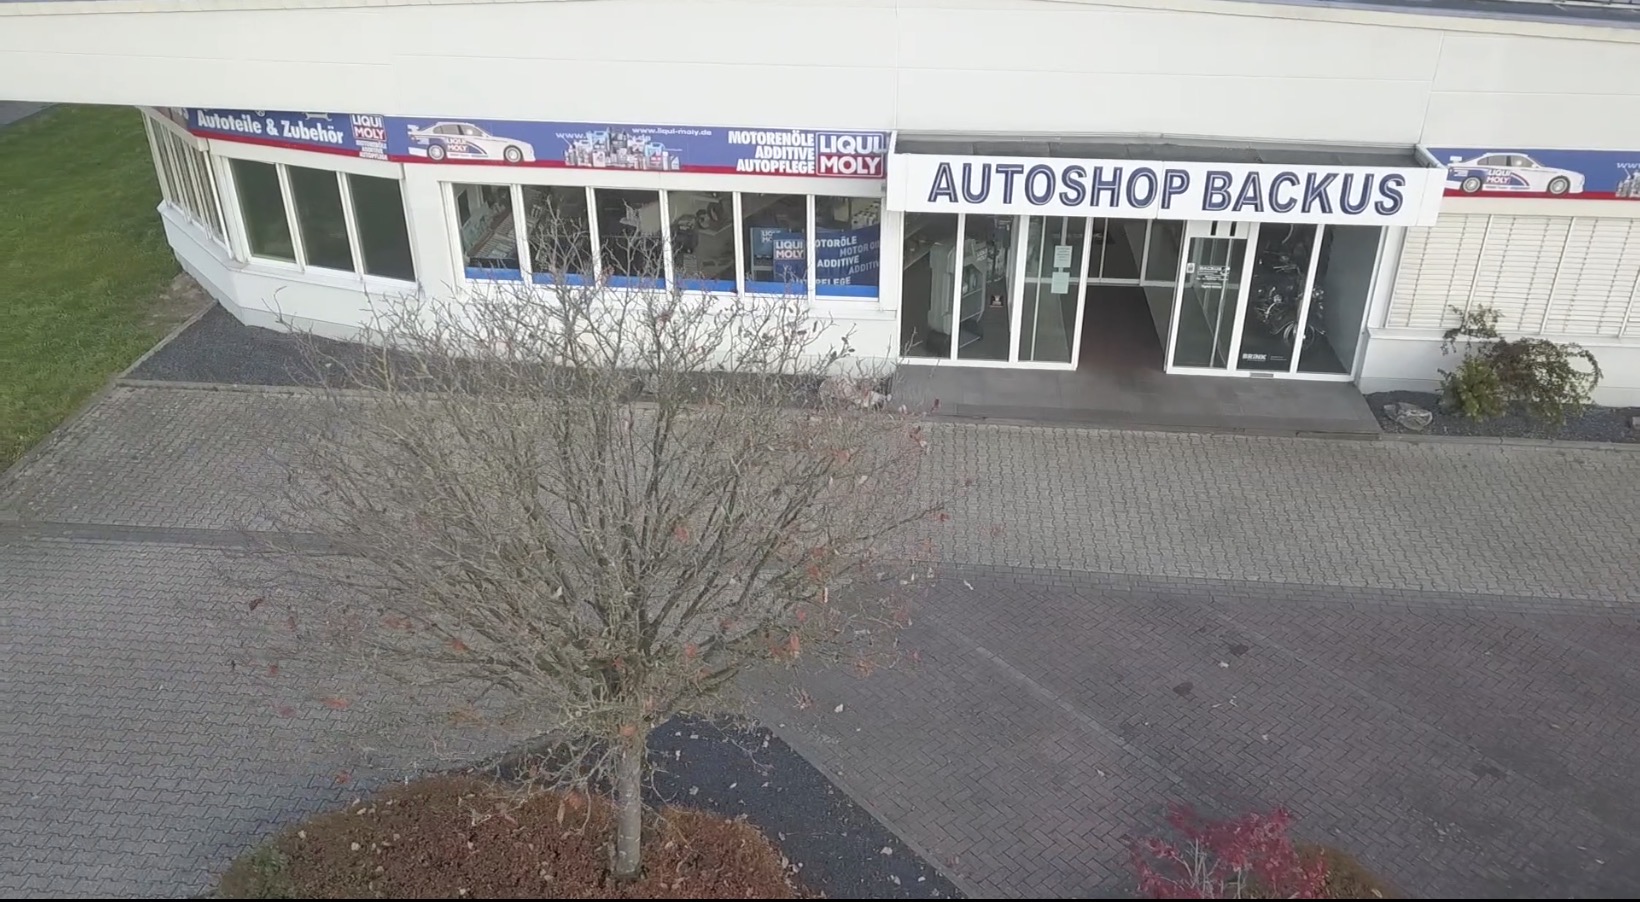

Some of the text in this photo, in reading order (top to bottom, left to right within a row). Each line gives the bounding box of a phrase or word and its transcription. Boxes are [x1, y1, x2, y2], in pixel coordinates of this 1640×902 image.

[198, 109, 262, 134] Autoteile
[266, 117, 279, 136] &
[281, 119, 344, 144] Zubehör
[352, 114, 383, 128] LIQUI
[354, 126, 385, 140] MOLY
[728, 130, 815, 146] MOTORENÖLE
[819, 134, 881, 155] LIQUI
[755, 145, 815, 160] ADDITIVE
[736, 159, 815, 175] AUTOPFLEGE
[820, 156, 881, 175] MOLY
[928, 162, 1406, 216] AUTOSHOP BACKUS
[775, 240, 803, 250] LIQUI
[815, 235, 858, 248] OTORÖLE
[776, 249, 804, 259] MOLY
[817, 255, 860, 268] ADDITIVE
